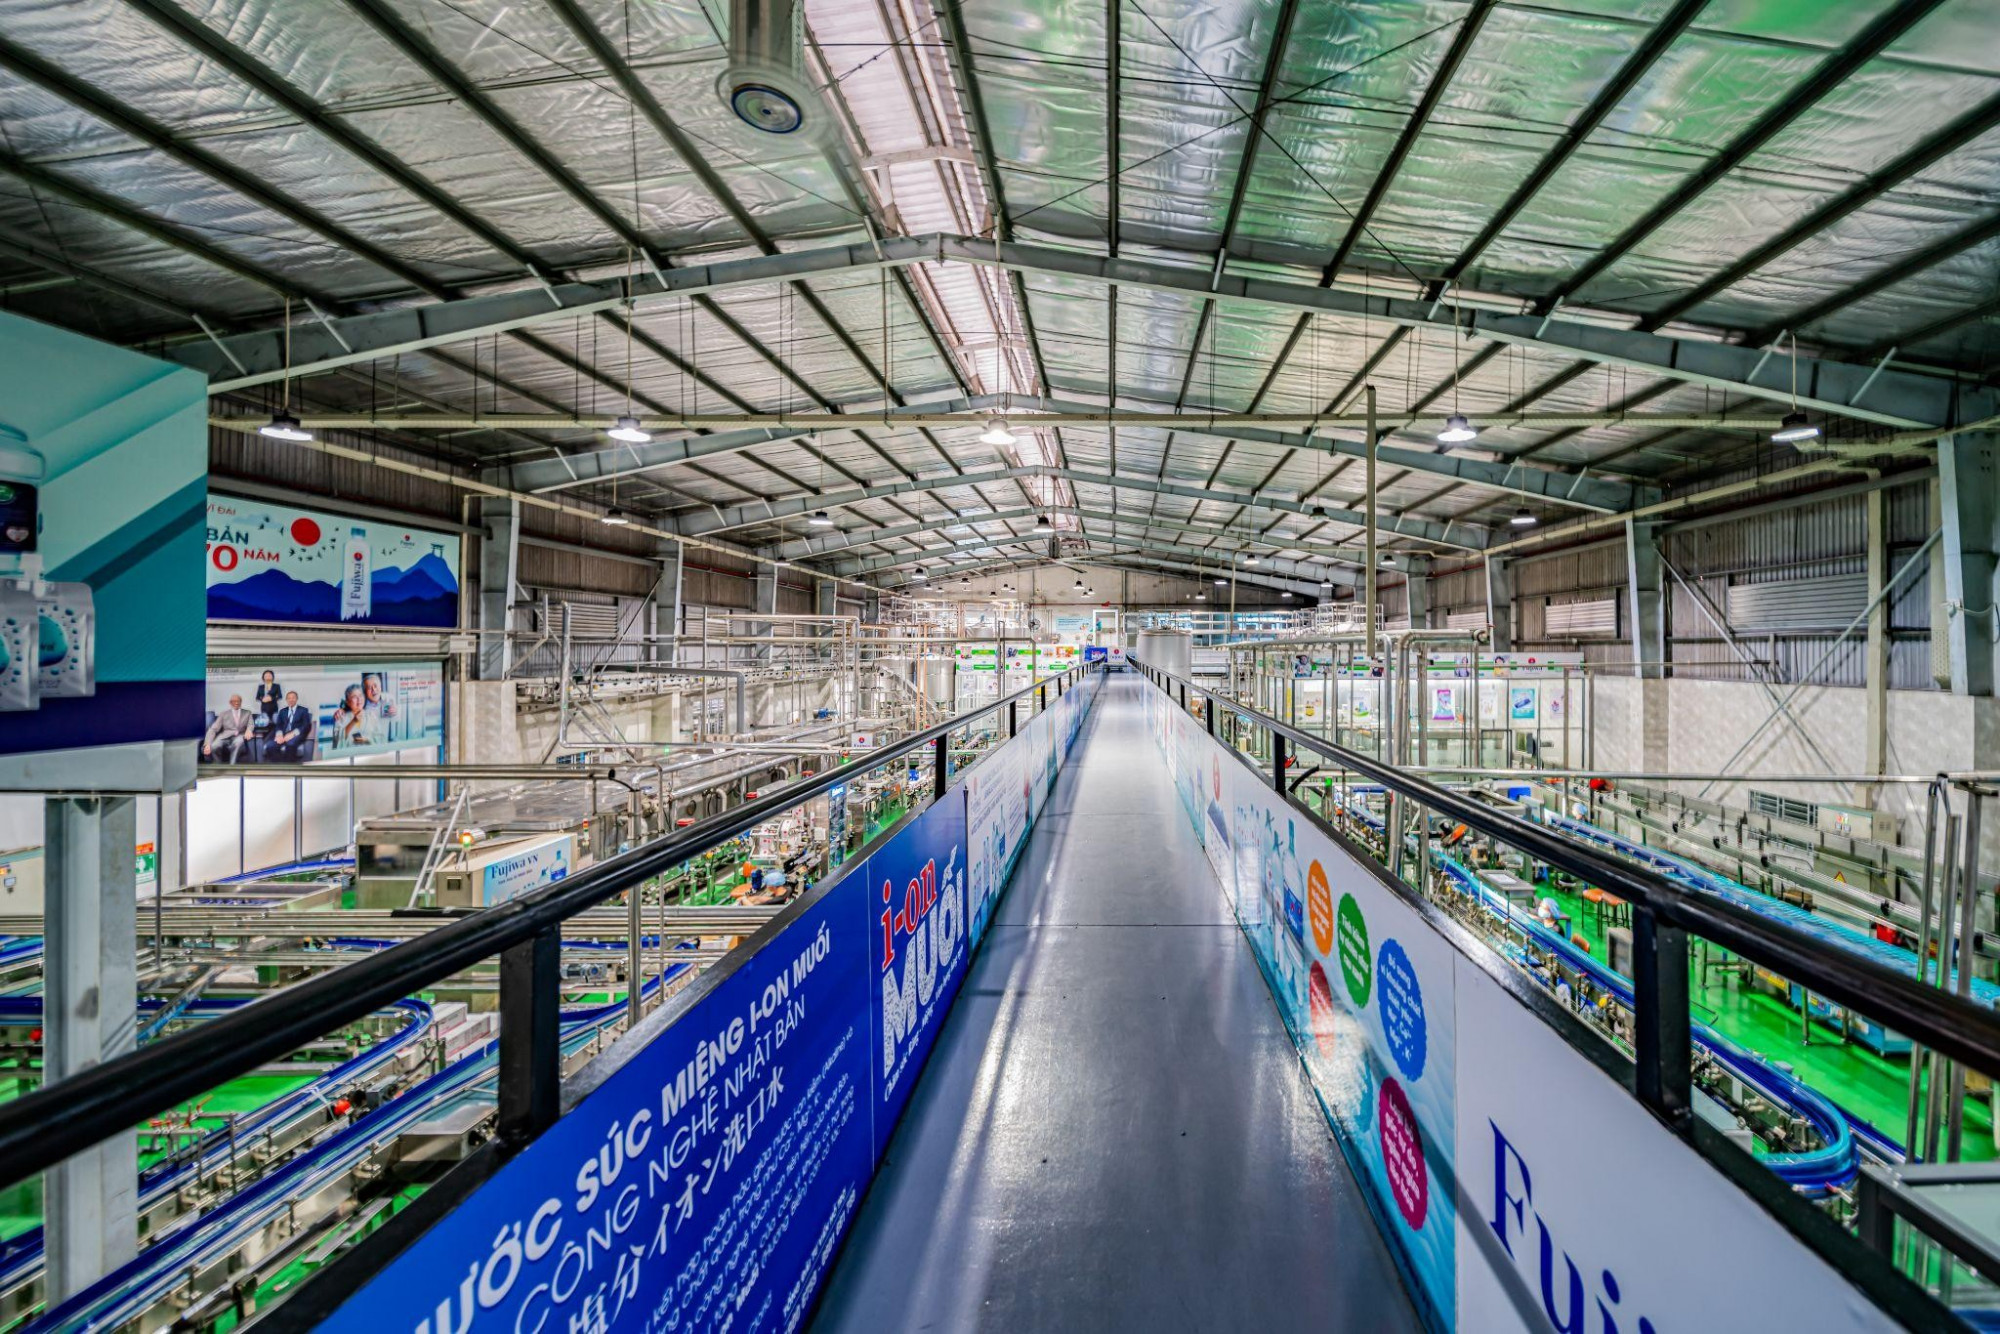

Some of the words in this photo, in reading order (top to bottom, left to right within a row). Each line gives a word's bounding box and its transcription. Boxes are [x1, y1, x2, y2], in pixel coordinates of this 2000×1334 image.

[243, 548, 280, 562] NĂM
[350, 562, 363, 600] Fujiwa
[491, 857, 526, 879] Fujiwa
[881, 857, 938, 972] i-on
[883, 844, 964, 1079] MUỐI
[577, 1109, 651, 1212] SÚC
[662, 1017, 744, 1126] MIỆNG
[750, 969, 788, 1033] I-ON
[793, 921, 829, 988] MUỐI
[515, 1184, 639, 1334] CÔNG
[649, 1086, 718, 1198] NGHỆ
[725, 1031, 771, 1109] NHẬT
[776, 995, 804, 1049] BẢN
[569, 1067, 783, 1334] 塩分イオン洗口水
[704, 1208, 730, 1252] hoàn
[711, 1221, 737, 1265] quan
[695, 1274, 723, 1323] công
[736, 1263, 759, 1311] Muối
